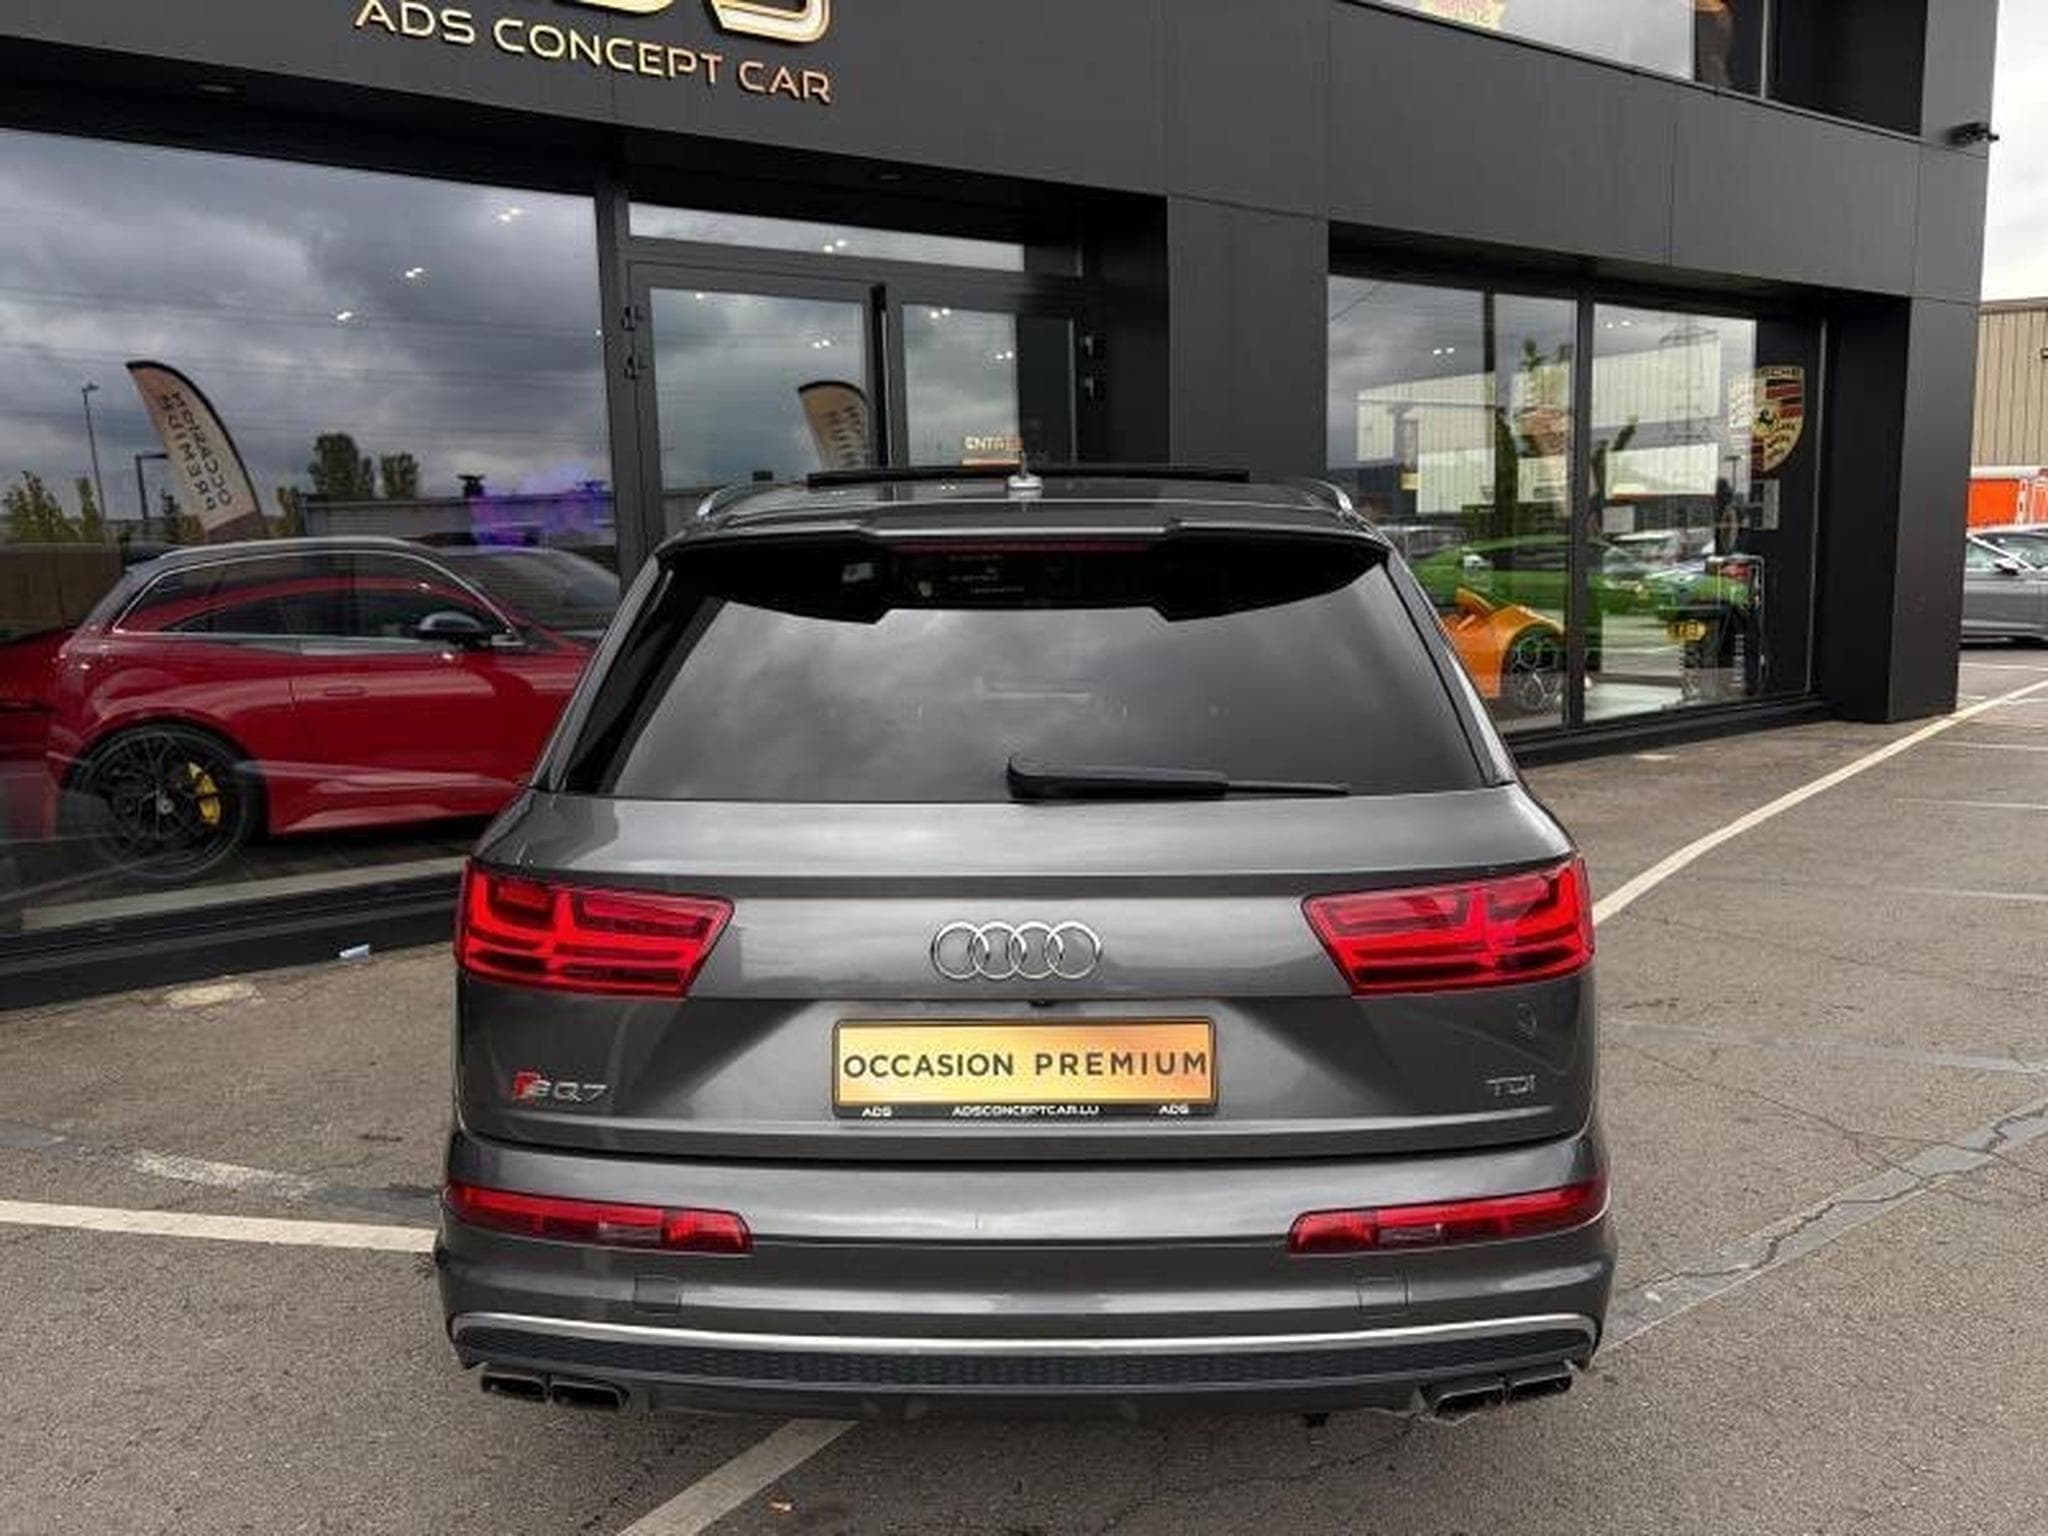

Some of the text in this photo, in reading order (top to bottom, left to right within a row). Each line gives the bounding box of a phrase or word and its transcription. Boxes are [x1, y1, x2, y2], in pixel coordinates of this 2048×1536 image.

[355, 0, 475, 45] ADS
[493, 20, 723, 84] CONCEPT
[738, 61, 831, 102] CAR
[843, 1052, 1207, 1078] OCCASION PREMIUM
[1485, 1074, 1535, 1097] TDI
